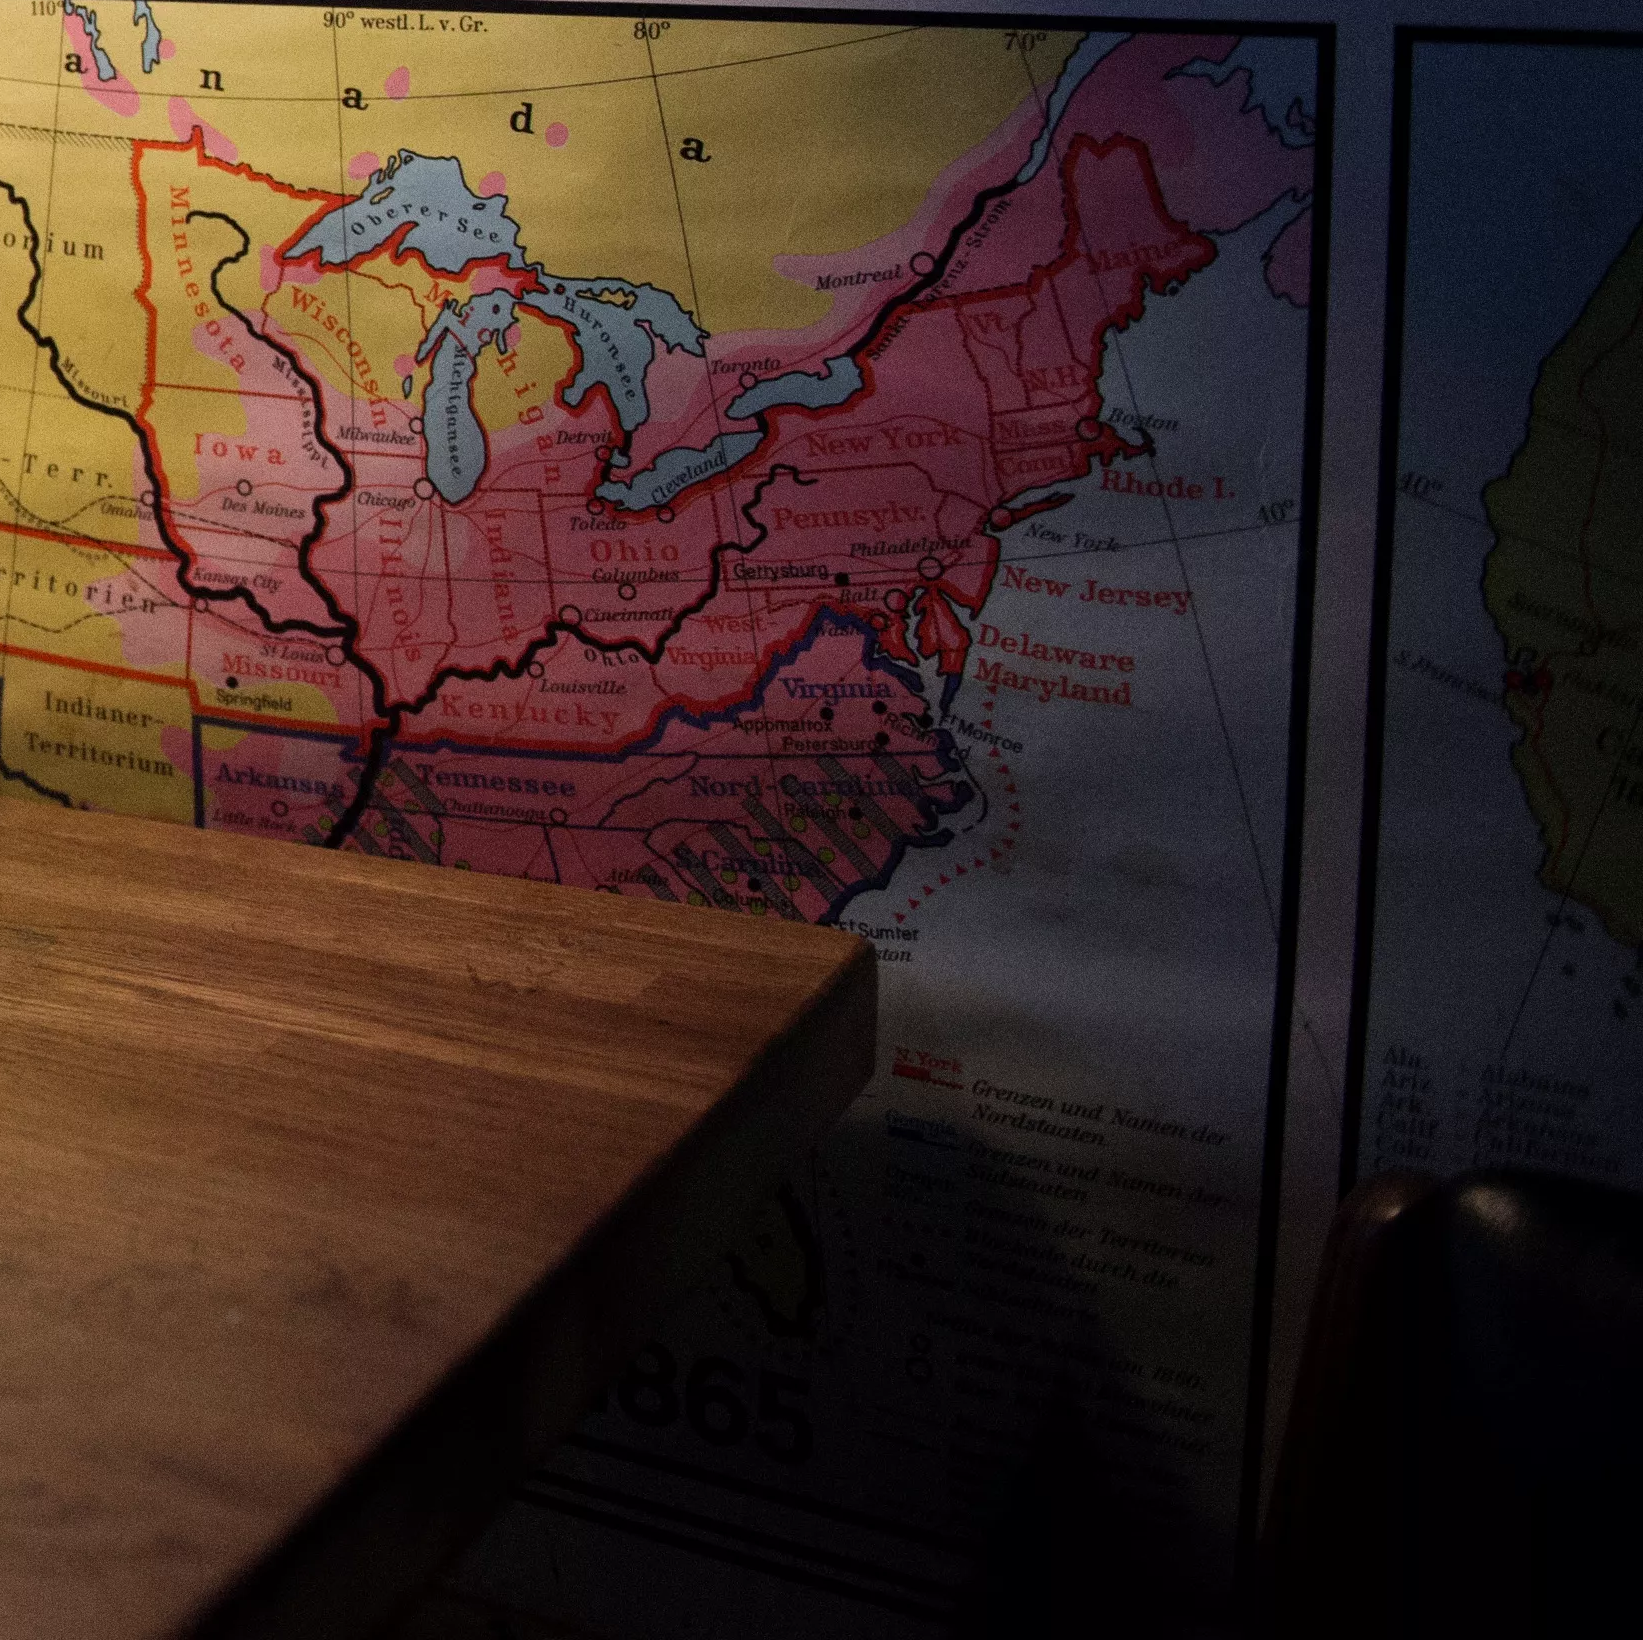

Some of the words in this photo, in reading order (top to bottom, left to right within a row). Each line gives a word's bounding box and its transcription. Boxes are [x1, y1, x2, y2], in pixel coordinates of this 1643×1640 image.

[351, 204, 447, 236] Oberer
[457, 218, 502, 242] See
[1091, 241, 1183, 270] Maine
[170, 186, 246, 374] Minnesota
[816, 266, 903, 289] Montreal
[291, 286, 386, 428] Wisconsin
[562, 296, 637, 401] Huronsee
[712, 356, 780, 374] Toronto
[336, 425, 416, 445] Milwaukee
[556, 430, 611, 444] Detroit
[806, 430, 874, 456] New
[883, 429, 963, 448] York
[194, 435, 284, 465] Iowa
[651, 450, 727, 505] Cleveland
[1101, 470, 1203, 500] Rhode
[1213, 478, 1236, 500] I.
[222, 497, 250, 511] Des
[254, 500, 305, 519] Moines
[357, 491, 416, 509] Chicago
[773, 505, 926, 529] Pennsylv.
[590, 541, 680, 563] Ohio
[849, 537, 972, 556] Philadelphia
[484, 508, 517, 641] Indiana
[592, 568, 680, 583] Columbus
[733, 561, 828, 580] Gettysburg
[1001, 565, 1069, 595] New
[1079, 580, 1194, 611] Jersey
[584, 608, 674, 622] Cincinnati
[666, 647, 755, 668] Virginia
[978, 624, 1136, 673] Delaware
[221, 653, 342, 688] Missouri
[974, 658, 1131, 708] Maryland
[217, 689, 293, 713] Springfield
[539, 679, 627, 696] Louisville
[778, 678, 894, 700] Virginia
[45, 692, 163, 727] Indianer-
[440, 694, 620, 726] Kentucky
[733, 717, 833, 733] Appomattox
[25, 731, 174, 776] Territorium
[782, 737, 881, 754] Petersburg
[216, 763, 345, 799] Arkansas
[418, 765, 576, 796] Tennessee
[858, 922, 918, 942] Sumter
[971, 1079, 1055, 1111] Grenzen
[1061, 1100, 1103, 1121] und
[1114, 1109, 1185, 1136] Namen
[1188, 1126, 1229, 1146] der
[600, 1342, 814, 1463] 865
